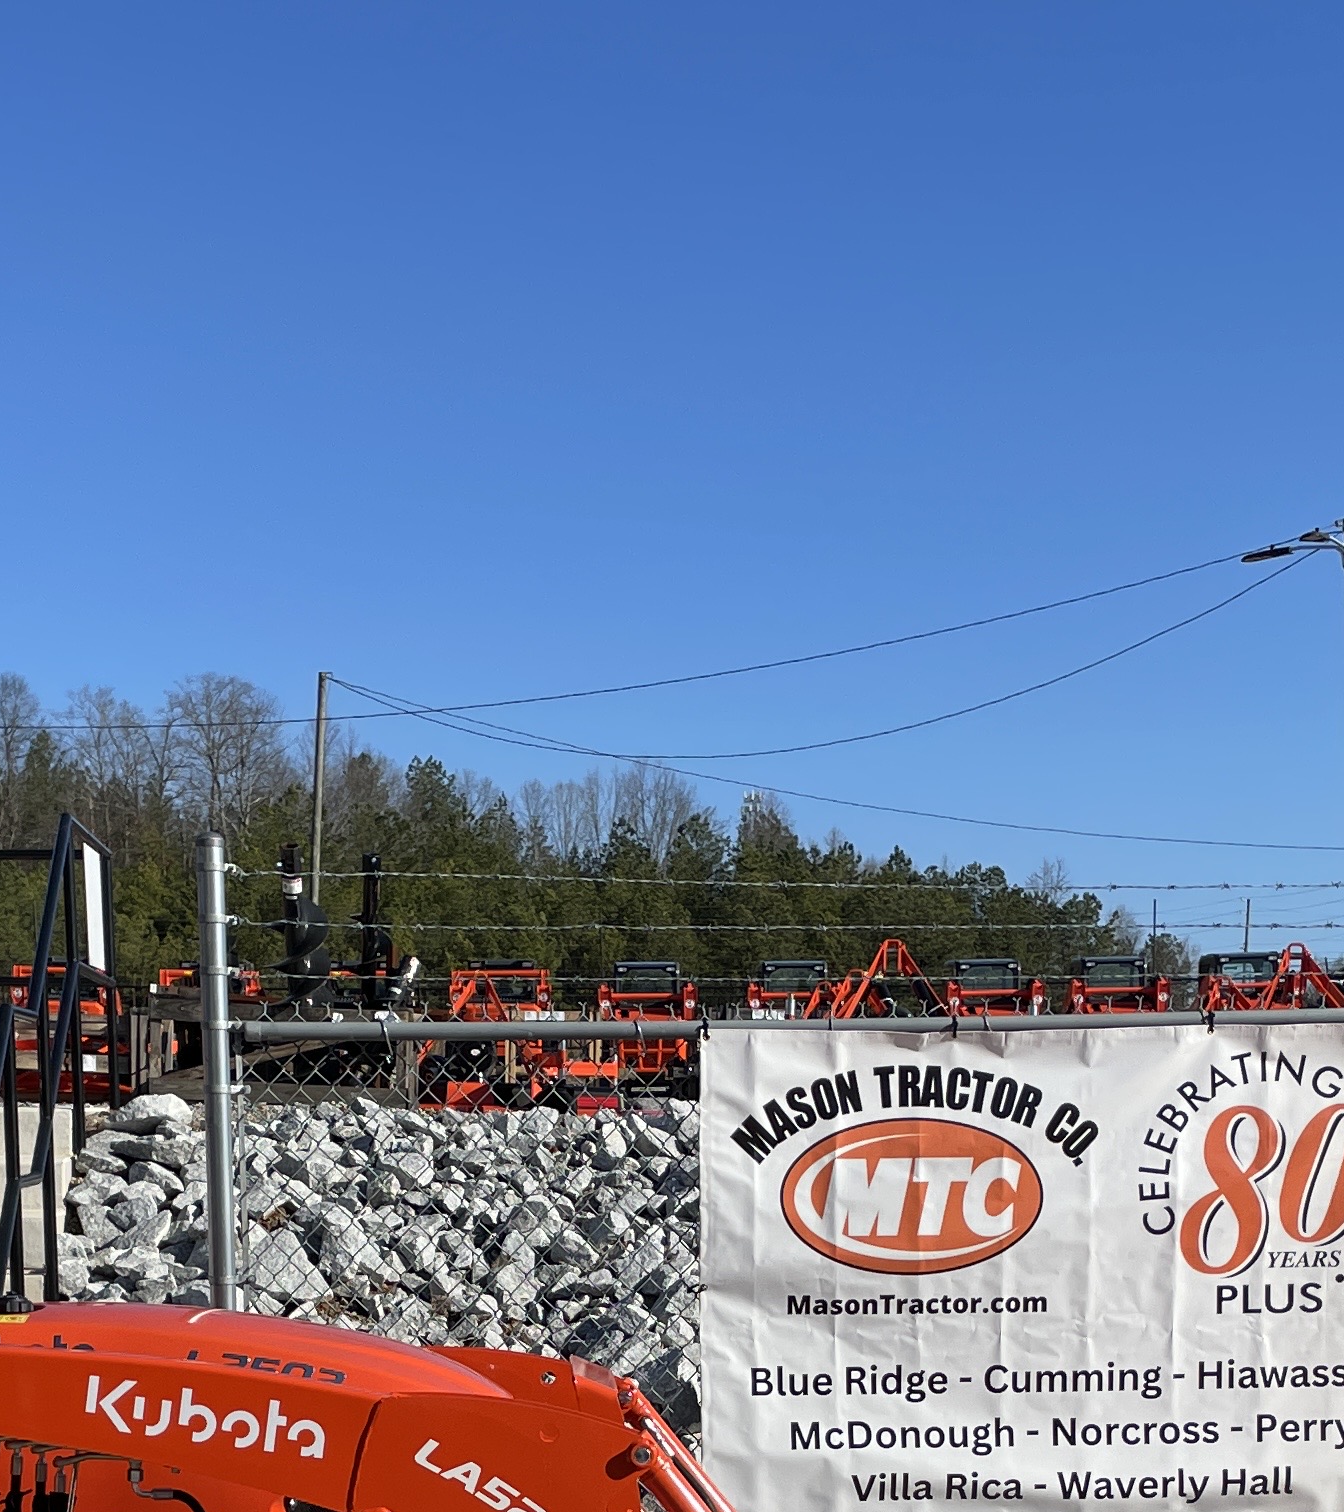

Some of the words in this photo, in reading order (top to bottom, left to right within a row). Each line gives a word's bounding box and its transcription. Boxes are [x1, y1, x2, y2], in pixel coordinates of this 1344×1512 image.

[729, 1070, 863, 1166] MASON
[873, 1064, 1043, 1129] TRACTOR
[1044, 1102, 1101, 1168] CO.
[1138, 1050, 1344, 1236] CELEBRATING
[830, 1157, 1023, 1238] MTC
[1266, 1248, 1342, 1270] YEARS
[786, 1293, 1049, 1317] MasonTractor.com
[1214, 1282, 1324, 1316] PLUS
[750, 1365, 834, 1397] Blue
[844, 1364, 950, 1403] Ridge
[983, 1362, 1163, 1400] Cumming
[84, 1373, 326, 1460] Kubota
[789, 1418, 1016, 1456] McDonough
[1051, 1416, 1220, 1447] Norcross
[851, 1471, 934, 1502] Villa
[945, 1470, 1024, 1501] Rica
[1057, 1469, 1210, 1506] Waverly
[1221, 1466, 1294, 1497] Hall
